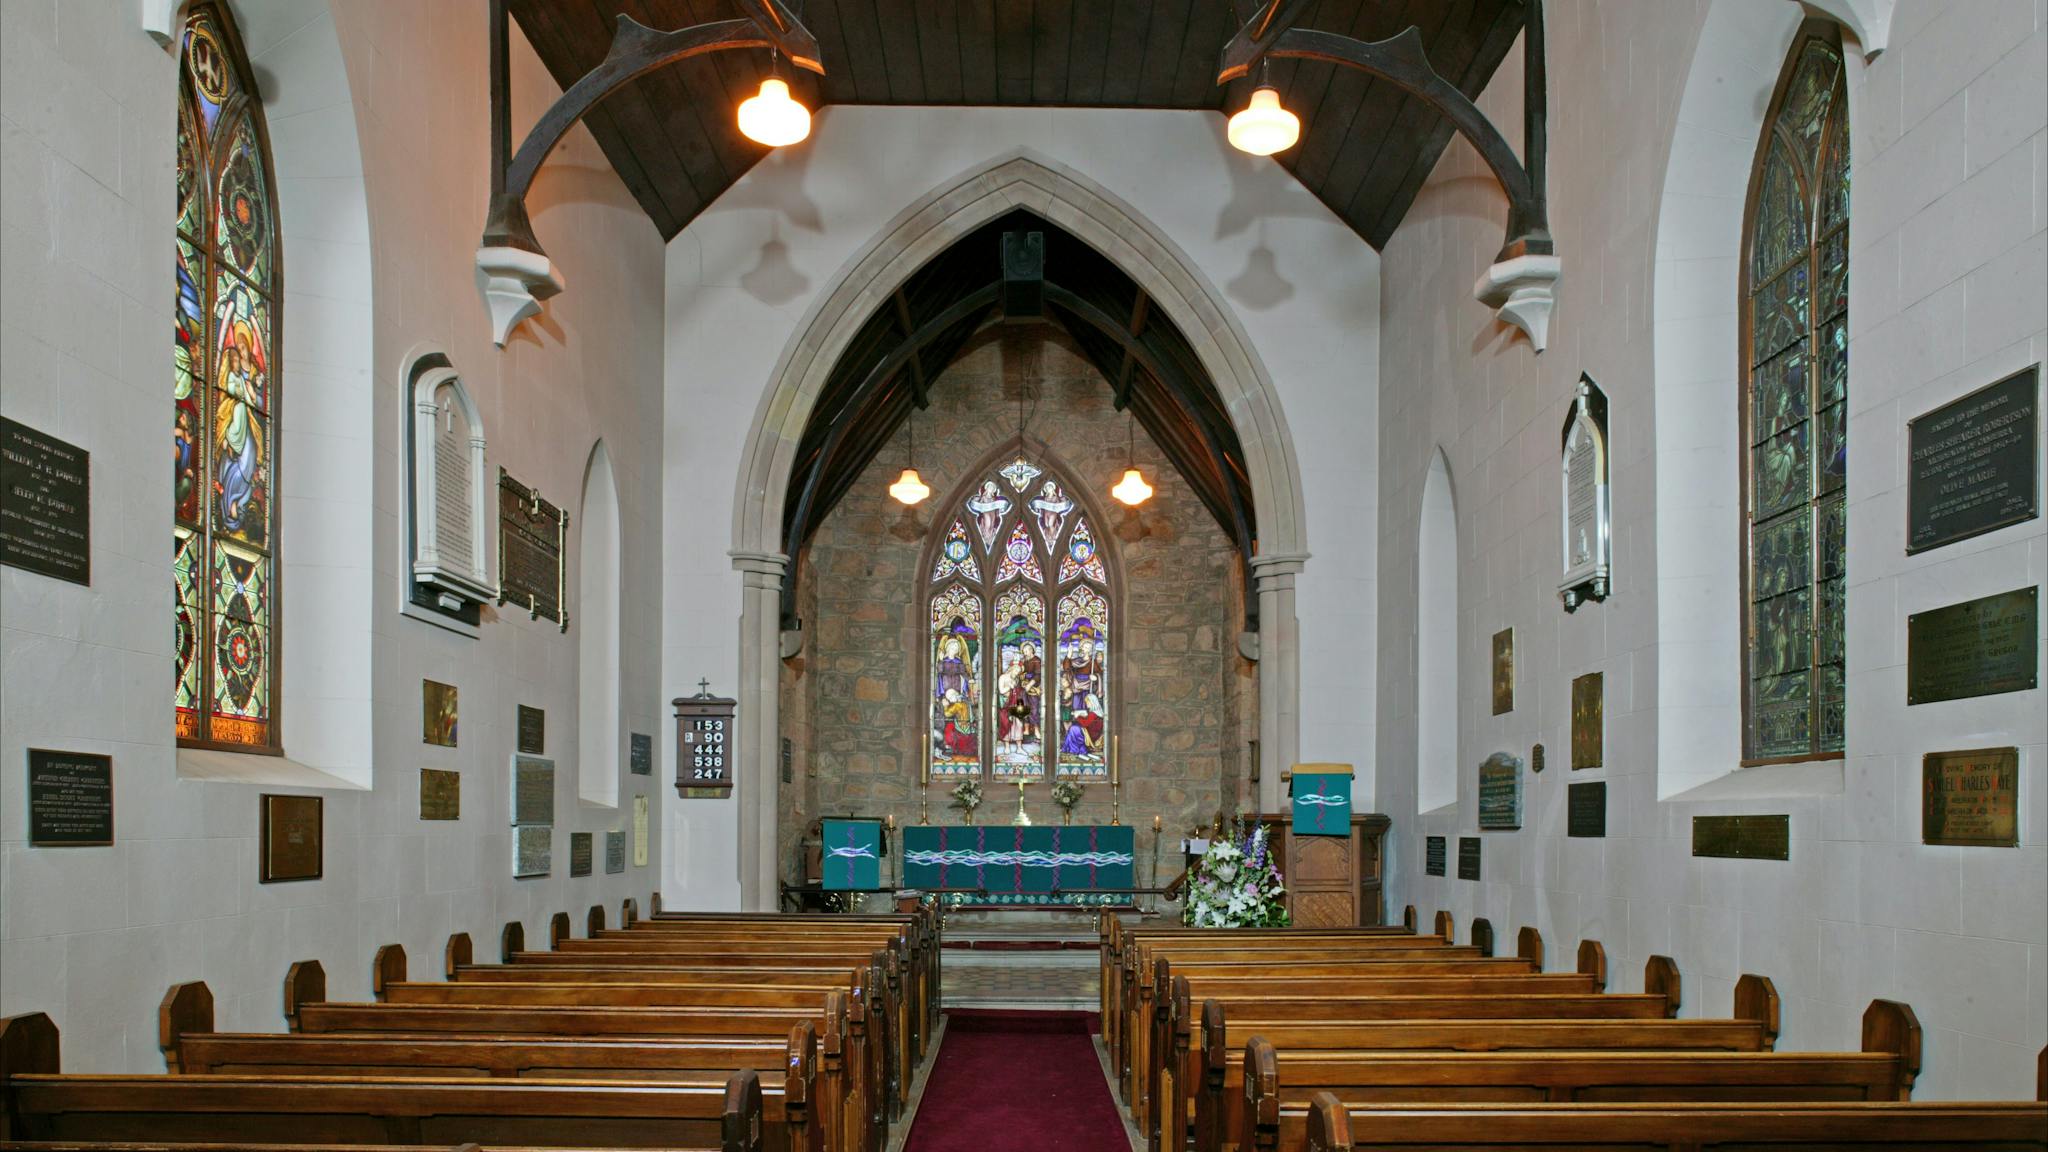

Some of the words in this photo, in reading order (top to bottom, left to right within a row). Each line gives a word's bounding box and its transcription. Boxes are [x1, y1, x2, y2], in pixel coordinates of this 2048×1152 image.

[1967, 467, 1997, 486] MARIE
[696, 720, 723, 730] 153
[705, 732, 723, 743] 90
[695, 744, 723, 755] 444
[695, 756, 723, 767] 538
[695, 769, 723, 779] 247
[1956, 775, 1990, 792] CHARLES
